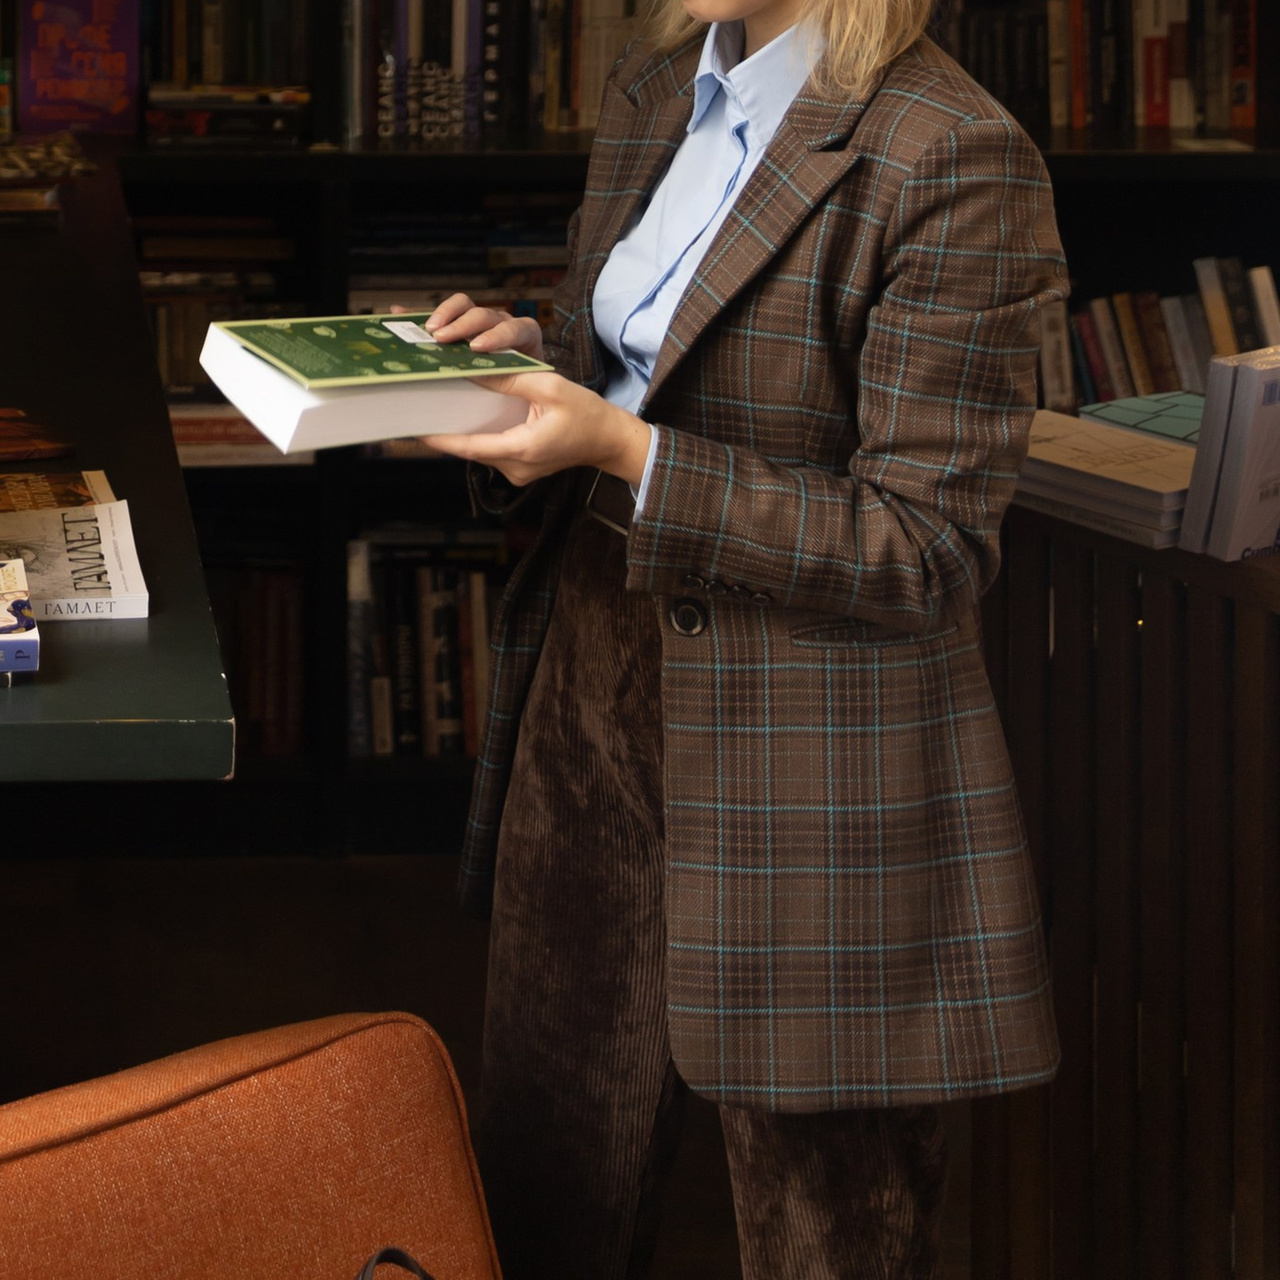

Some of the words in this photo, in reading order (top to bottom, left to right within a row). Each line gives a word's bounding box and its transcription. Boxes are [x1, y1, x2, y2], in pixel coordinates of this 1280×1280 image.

[377, 62, 395, 138] СЕАНС
[484, 0, 500, 123] ГЕРМАН
[61, 512, 112, 592] ГАМЛЕТ
[44, 600, 117, 616] ГАМЛЕТ
